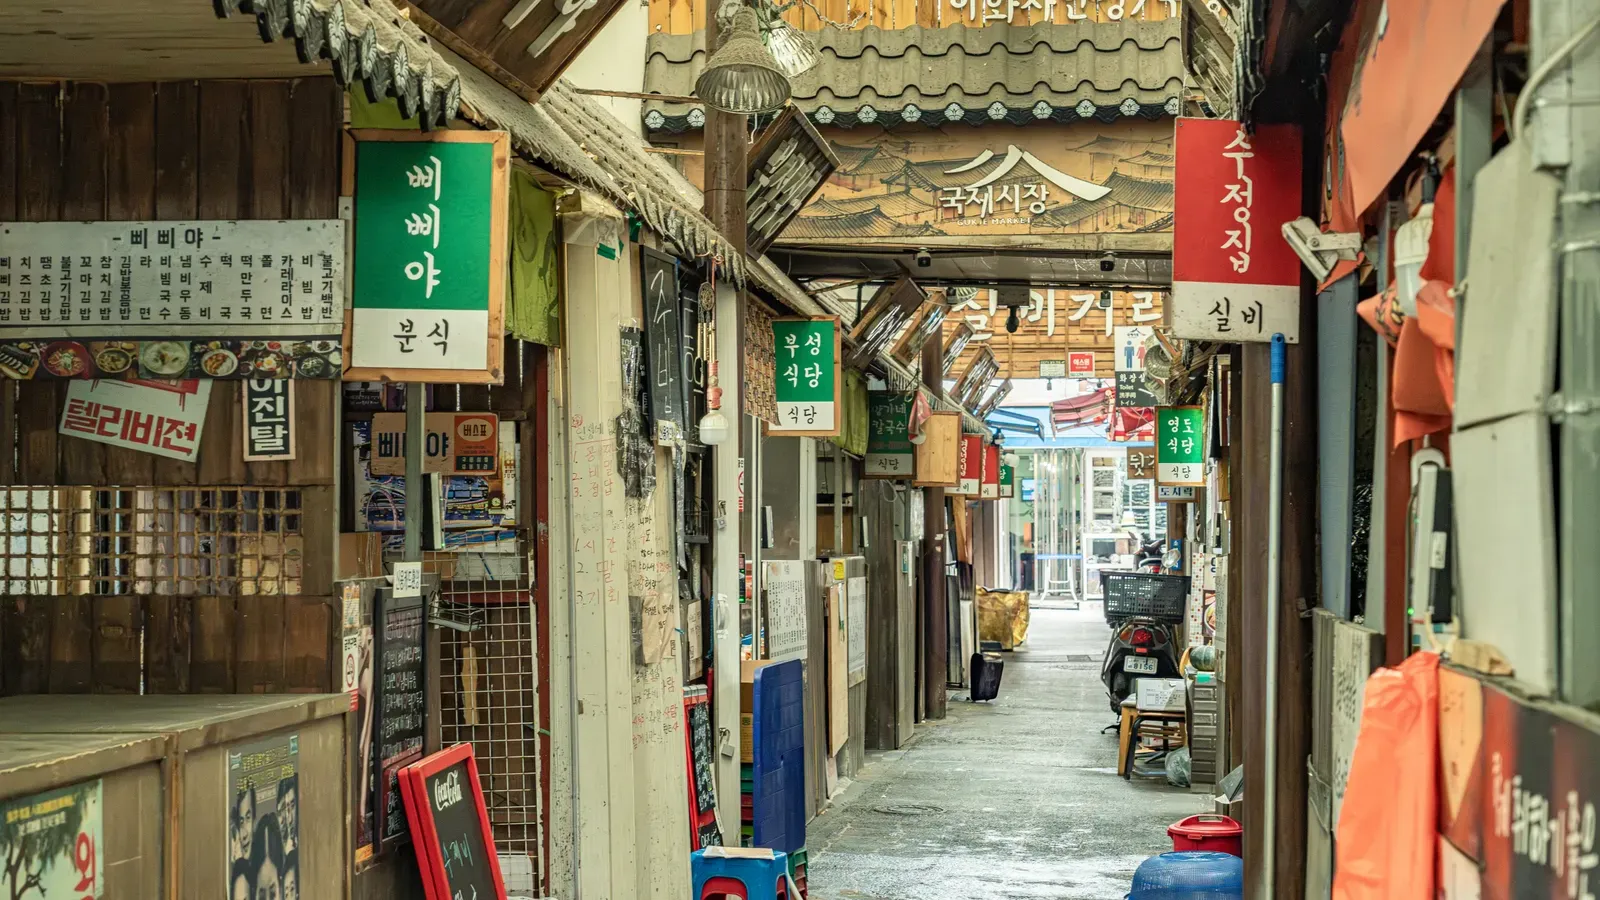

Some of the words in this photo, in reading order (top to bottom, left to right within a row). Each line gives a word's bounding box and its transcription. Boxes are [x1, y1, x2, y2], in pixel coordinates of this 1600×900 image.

[404, 155, 442, 299] 삐삐야
[939, 184, 1050, 218] 국제시장
[1219, 130, 1255, 273] 수정집
[20, 256, 32, 320] 치즈김밥
[40, 256, 52, 320] 땡초김밥
[60, 256, 72, 320] 불고기김밥
[80, 256, 92, 320] 꼬마김밥
[100, 256, 112, 320] 참치김밥
[140, 256, 153, 320] 라면
[160, 256, 173, 320] 비빔국수
[179, 256, 192, 320] 냄비우동
[200, 256, 213, 320] 수제비
[220, 256, 233, 320] 떡국
[240, 256, 253, 320] 떡만두국
[260, 256, 273, 320] 쫄면
[280, 256, 294, 320] 카레라이스
[301, 256, 314, 320] 비빔밥
[320, 256, 334, 320] 불고기백반
[1208, 297, 1263, 334] 실비
[393, 318, 449, 357] 분식
[784, 332, 821, 359] 부성
[783, 363, 823, 388] 식당
[64, 398, 197, 456] 텔리비젼
[377, 432, 450, 458] 삐야
[462, 423, 488, 442] 버스표
[788, 405, 817, 425] 식당
[872, 419, 906, 435] 칼국수
[1167, 437, 1194, 455] 식당
[1168, 416, 1194, 434] 영도
[879, 458, 900, 470] 식당
[1171, 466, 1191, 479] 식당
